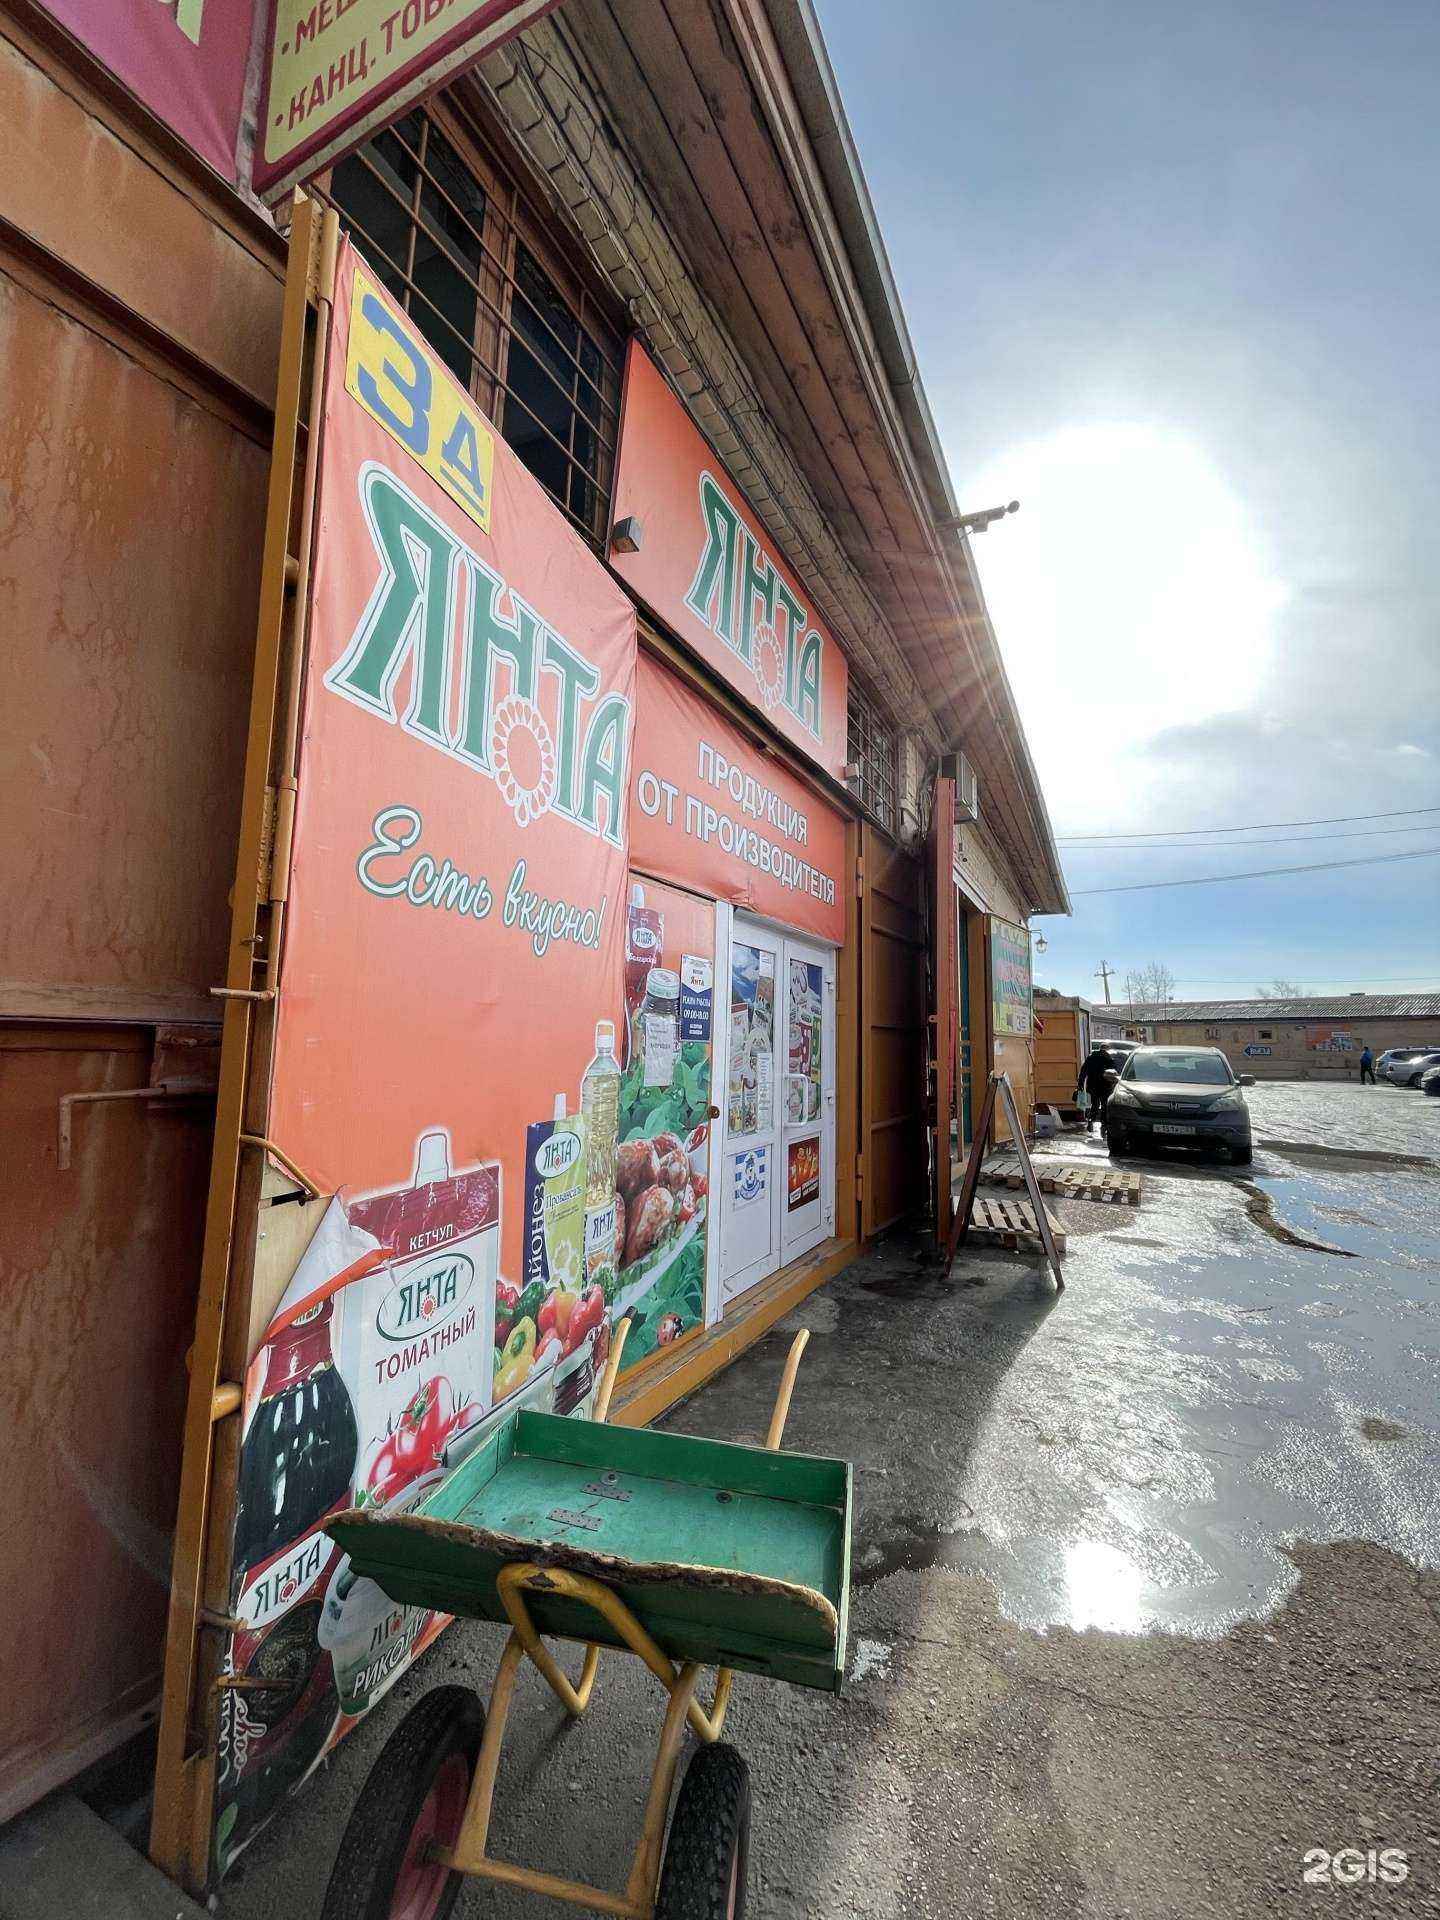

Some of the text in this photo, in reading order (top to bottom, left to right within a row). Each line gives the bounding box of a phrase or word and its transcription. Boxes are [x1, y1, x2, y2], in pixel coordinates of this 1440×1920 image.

[288, 38, 377, 132] КАНЦ.
[324, 459, 629, 851] ЯНТА
[683, 470, 825, 746] ЯНТА
[637, 769, 836, 907] ОТ ПРОИЗВОДИТЕЛЯ
[698, 740, 809, 846] ПРОДУКЦИЯ
[357, 804, 608, 958] Есть вкусно!
[543, 1140, 573, 1171] ЯНТА
[409, 1224, 454, 1251] КЕТЧУП
[396, 1262, 459, 1329] ЯНТА
[375, 1306, 476, 1385] ТОМАТНЫЙ
[253, 1538, 321, 1620] ЯНТА
